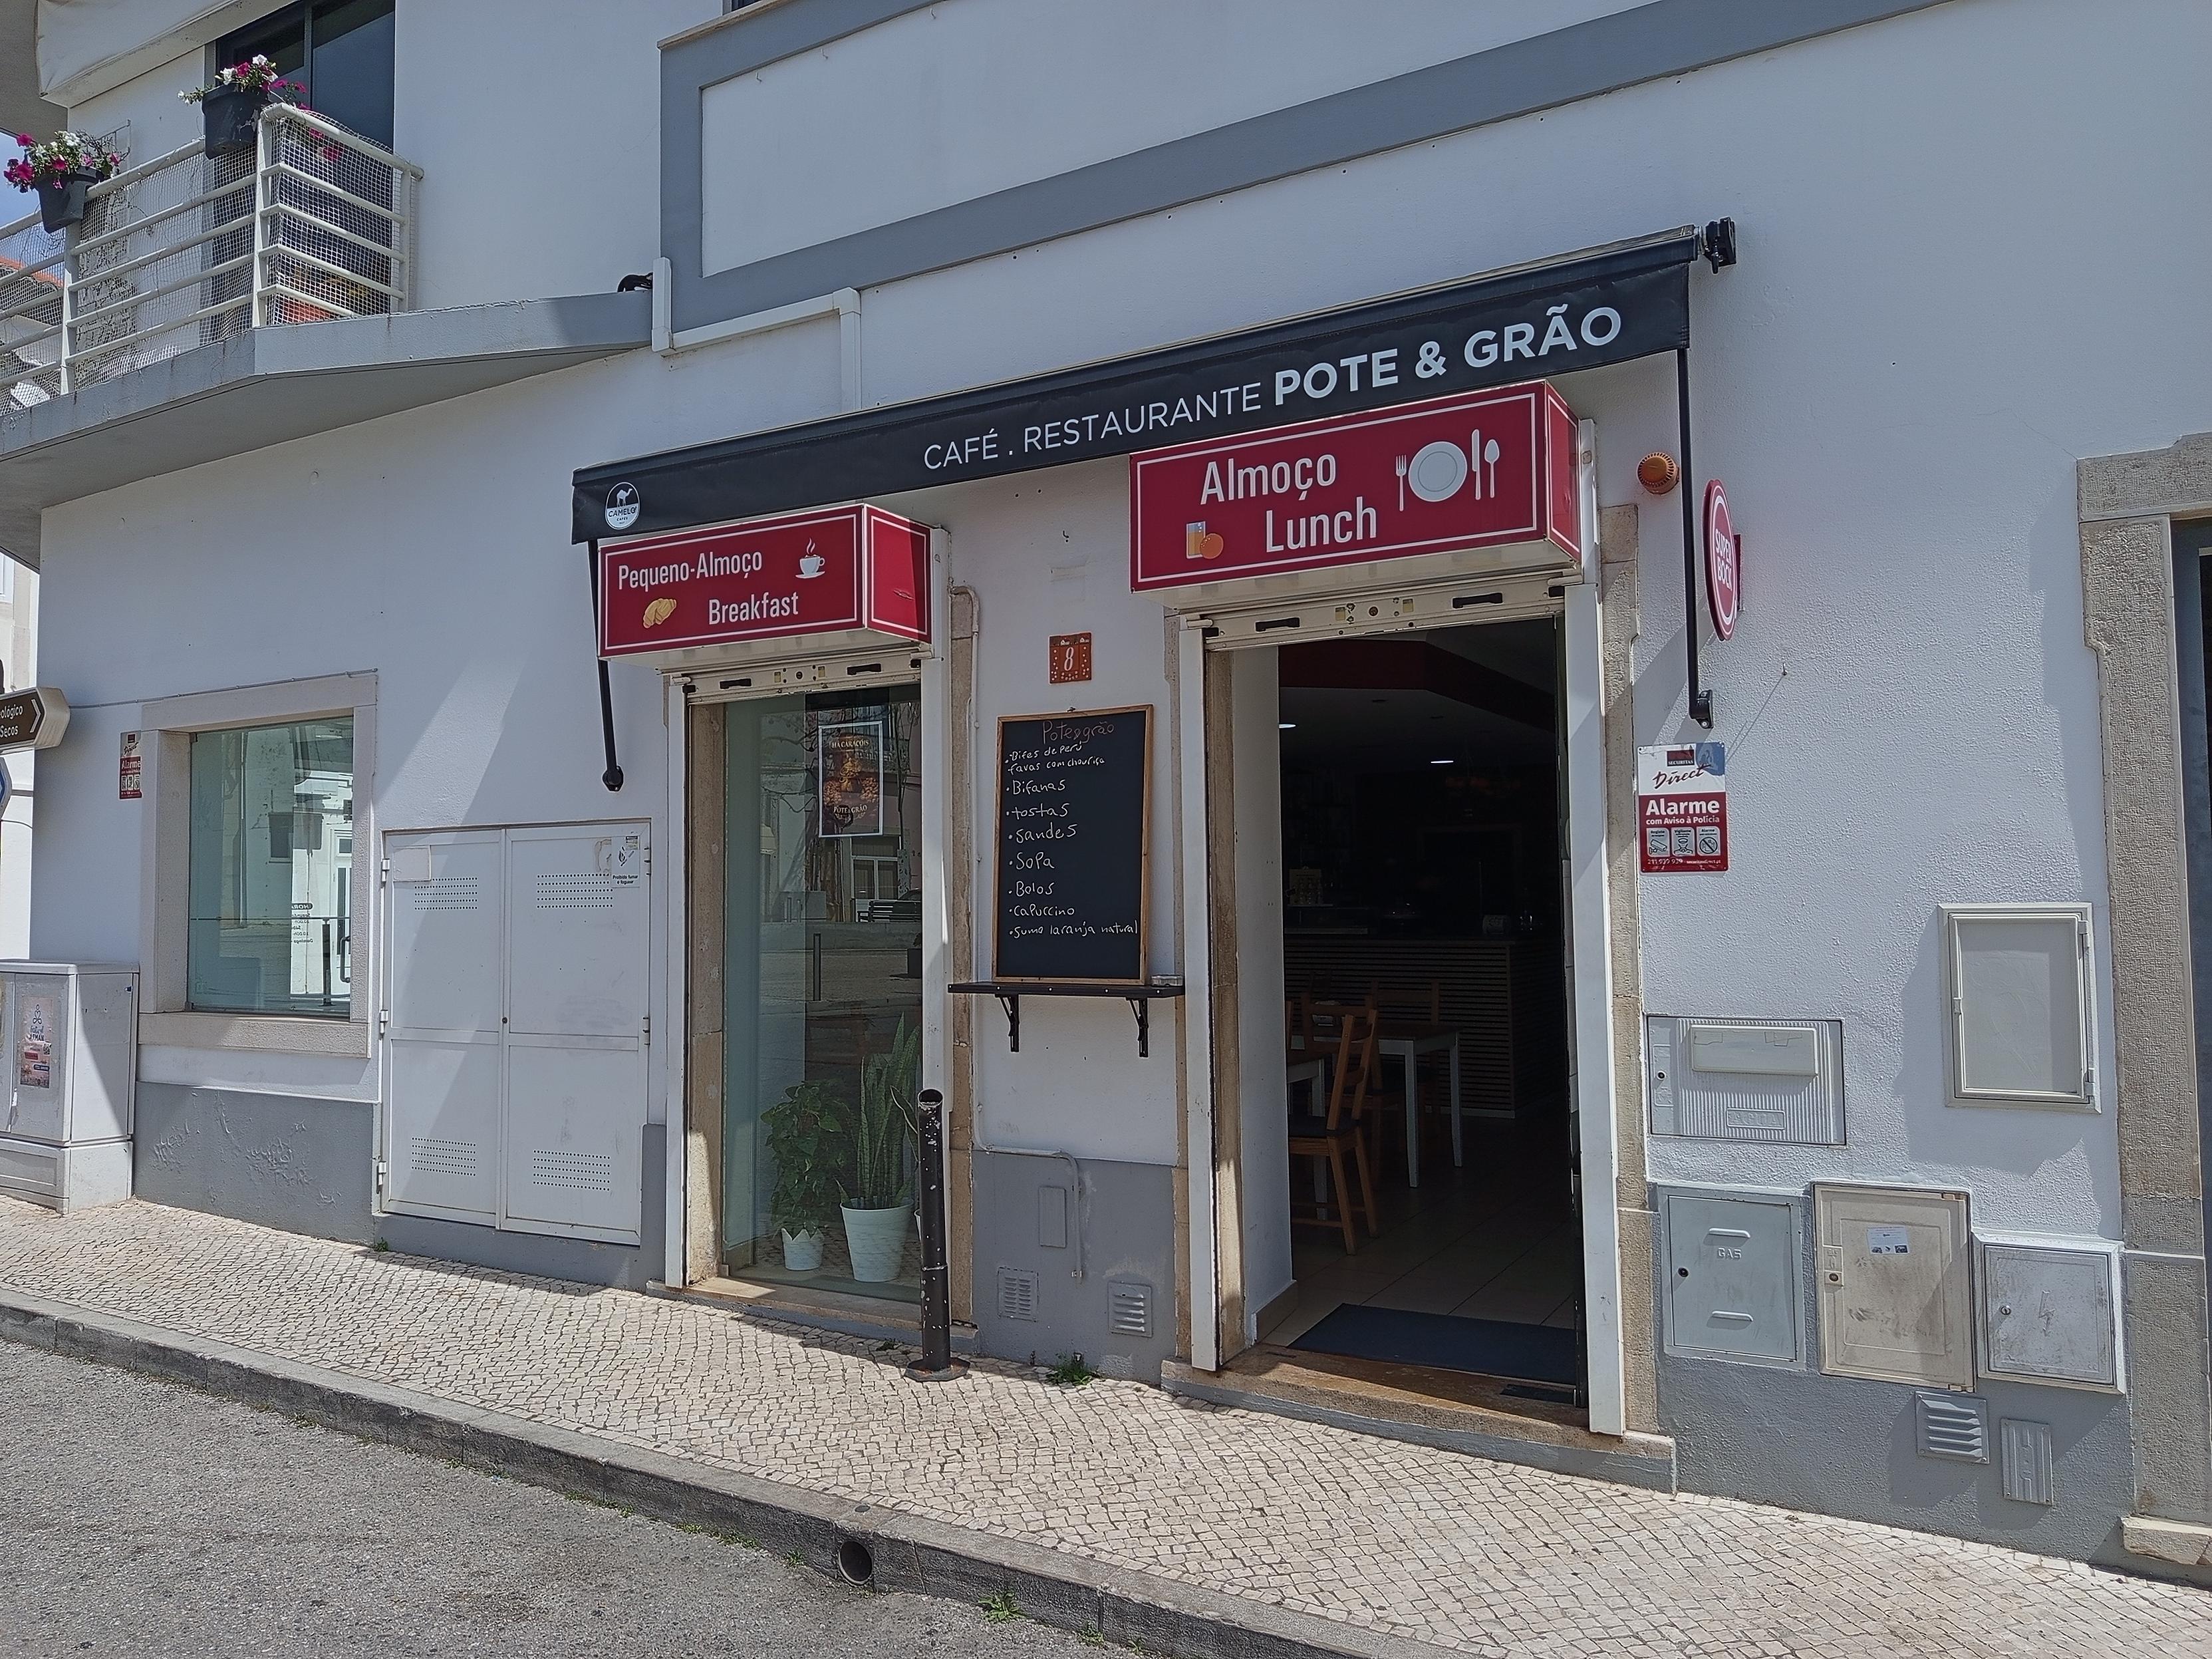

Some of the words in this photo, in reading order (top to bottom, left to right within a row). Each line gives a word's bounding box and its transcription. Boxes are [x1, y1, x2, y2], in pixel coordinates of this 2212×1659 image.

[923, 426, 998, 470] CAFÉ
[1023, 383, 1262, 454] RESTAURANTE
[1274, 347, 1399, 406] POTE
[1415, 341, 1448, 379] &
[1463, 303, 1623, 369] GRÃO
[1200, 454, 1337, 506] Almoço
[609, 506, 636, 518] CAMELO
[1266, 496, 1377, 553] Lunch
[1715, 529, 1732, 567] SUPER
[618, 550, 763, 593] Pequeno-Almoço
[1717, 556, 1732, 591] BOCK
[708, 590, 799, 626] Breakfast
[1064, 647, 1074, 671] 8
[0, 704, 23, 720] ológico
[0, 725, 19, 738] Secos
[1044, 746, 1057, 756] de
[1046, 760, 1064, 769] com
[1652, 764, 1712, 789] Direct
[1012, 779, 1066, 796] Bifanas
[1645, 798, 1720, 816] Alarme
[1663, 816, 1685, 825] Aviso
[1693, 815, 1721, 824] Polícia
[1016, 881, 1055, 897] Bolos
[1049, 921, 1096, 937] laranja
[1101, 919, 1138, 935] natural
[1718, 1247, 1742, 1259] GAS
